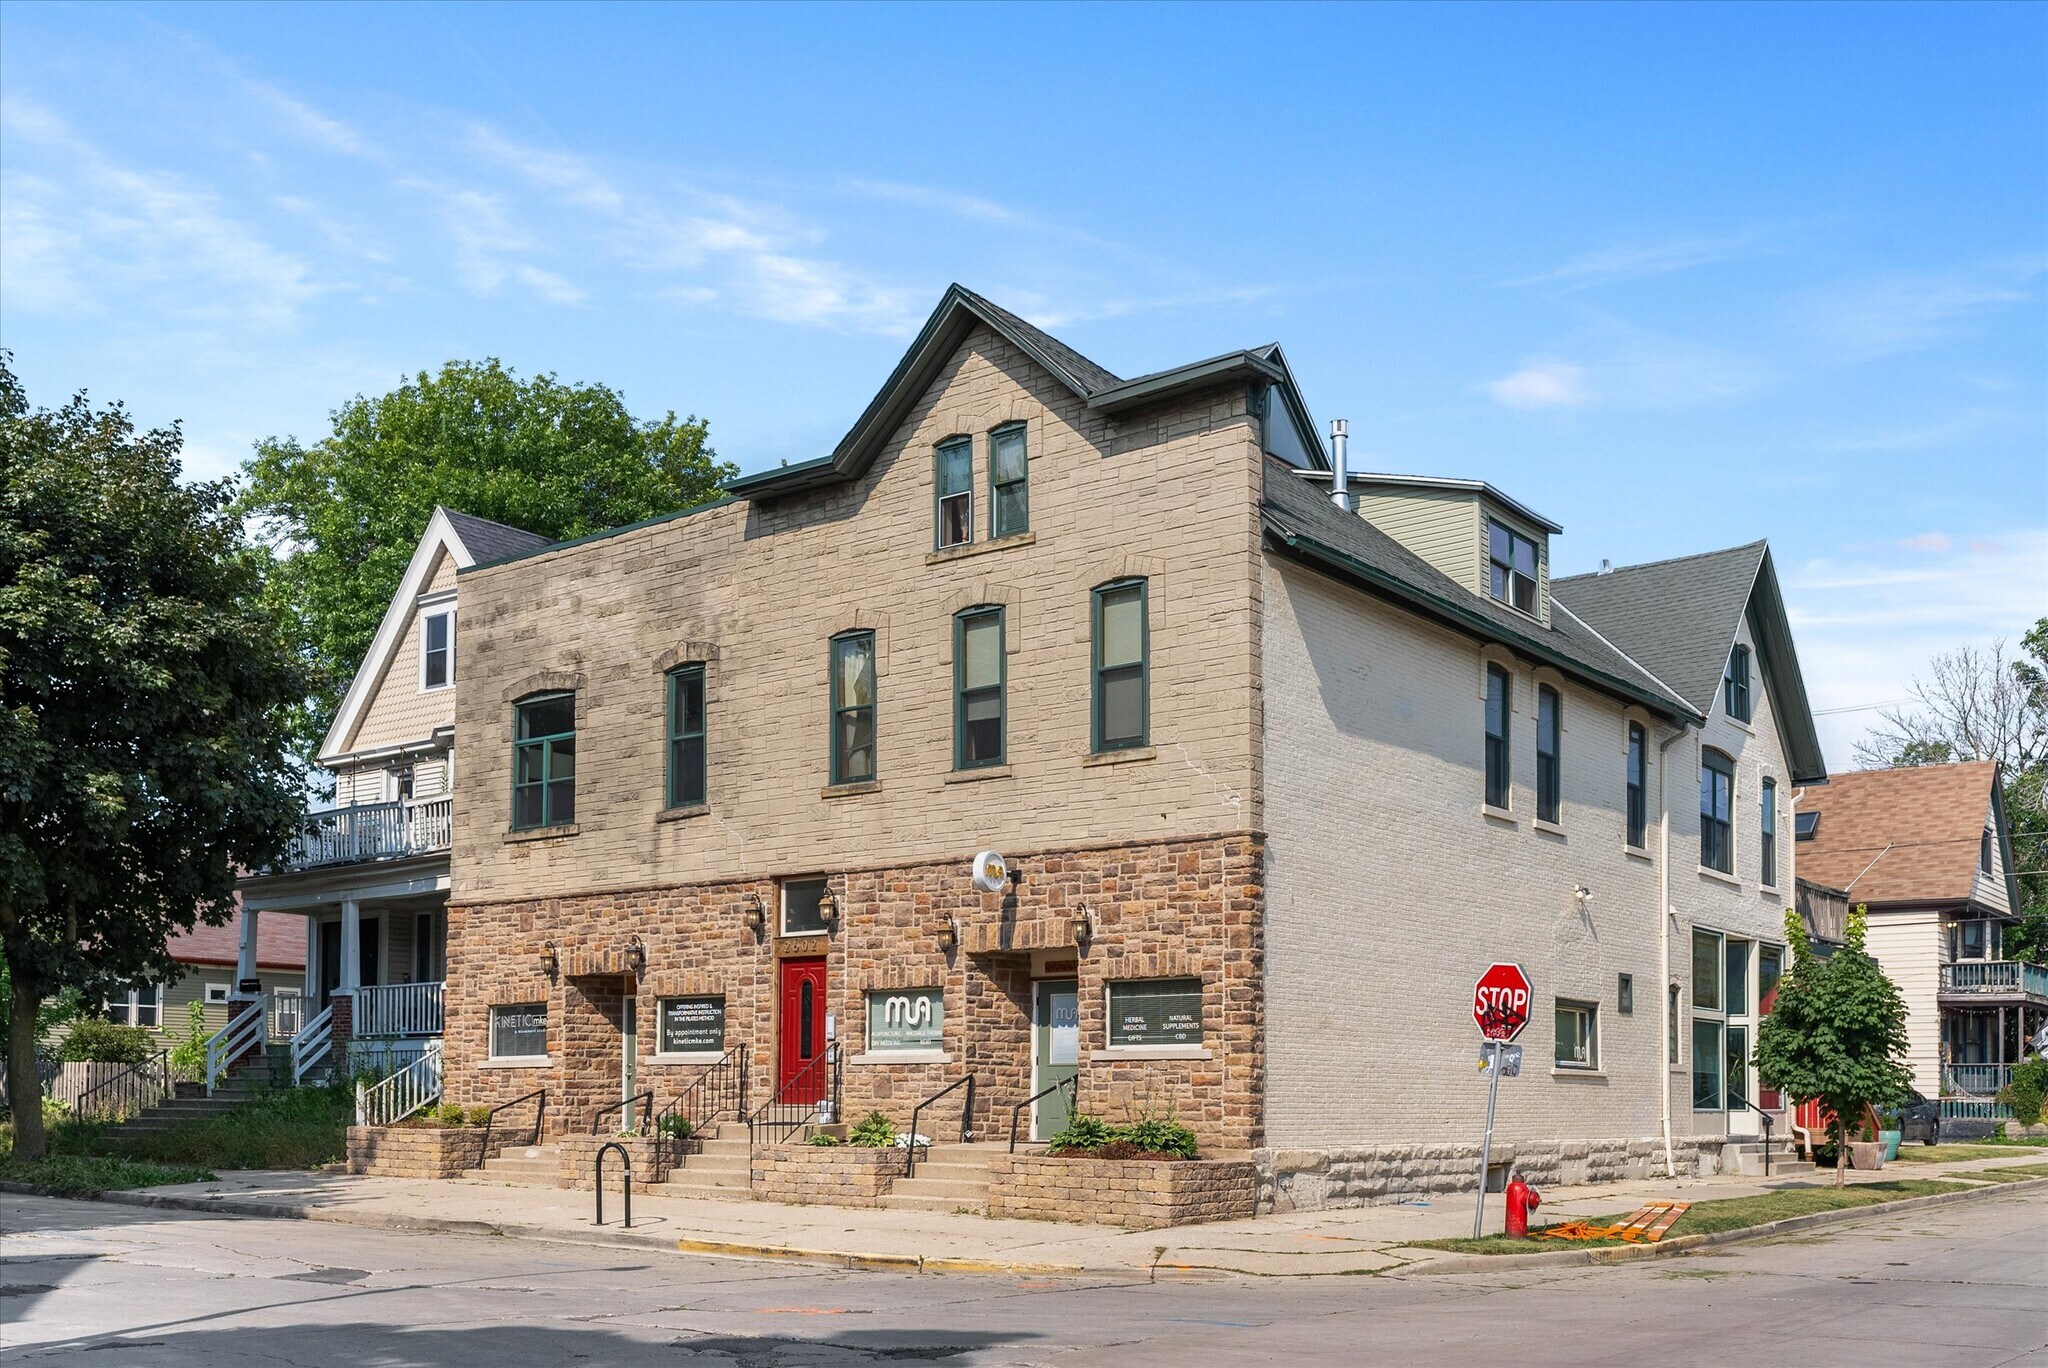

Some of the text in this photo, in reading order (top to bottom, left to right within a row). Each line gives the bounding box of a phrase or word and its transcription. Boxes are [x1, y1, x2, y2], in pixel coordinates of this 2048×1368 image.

[784, 940, 817, 953] 2602
[1475, 986, 1527, 1017] STOP
[494, 1014, 532, 1029] KINETIC
[1124, 1016, 1145, 1024] HERBAL
[1122, 1023, 1147, 1031] MEDICINE
[1162, 1022, 1200, 1030] SUPPLEMENTS
[666, 1027, 722, 1038] By appointment only
[673, 1037, 715, 1045] kineticmke.com
[1127, 1034, 1142, 1042] GIFTS
